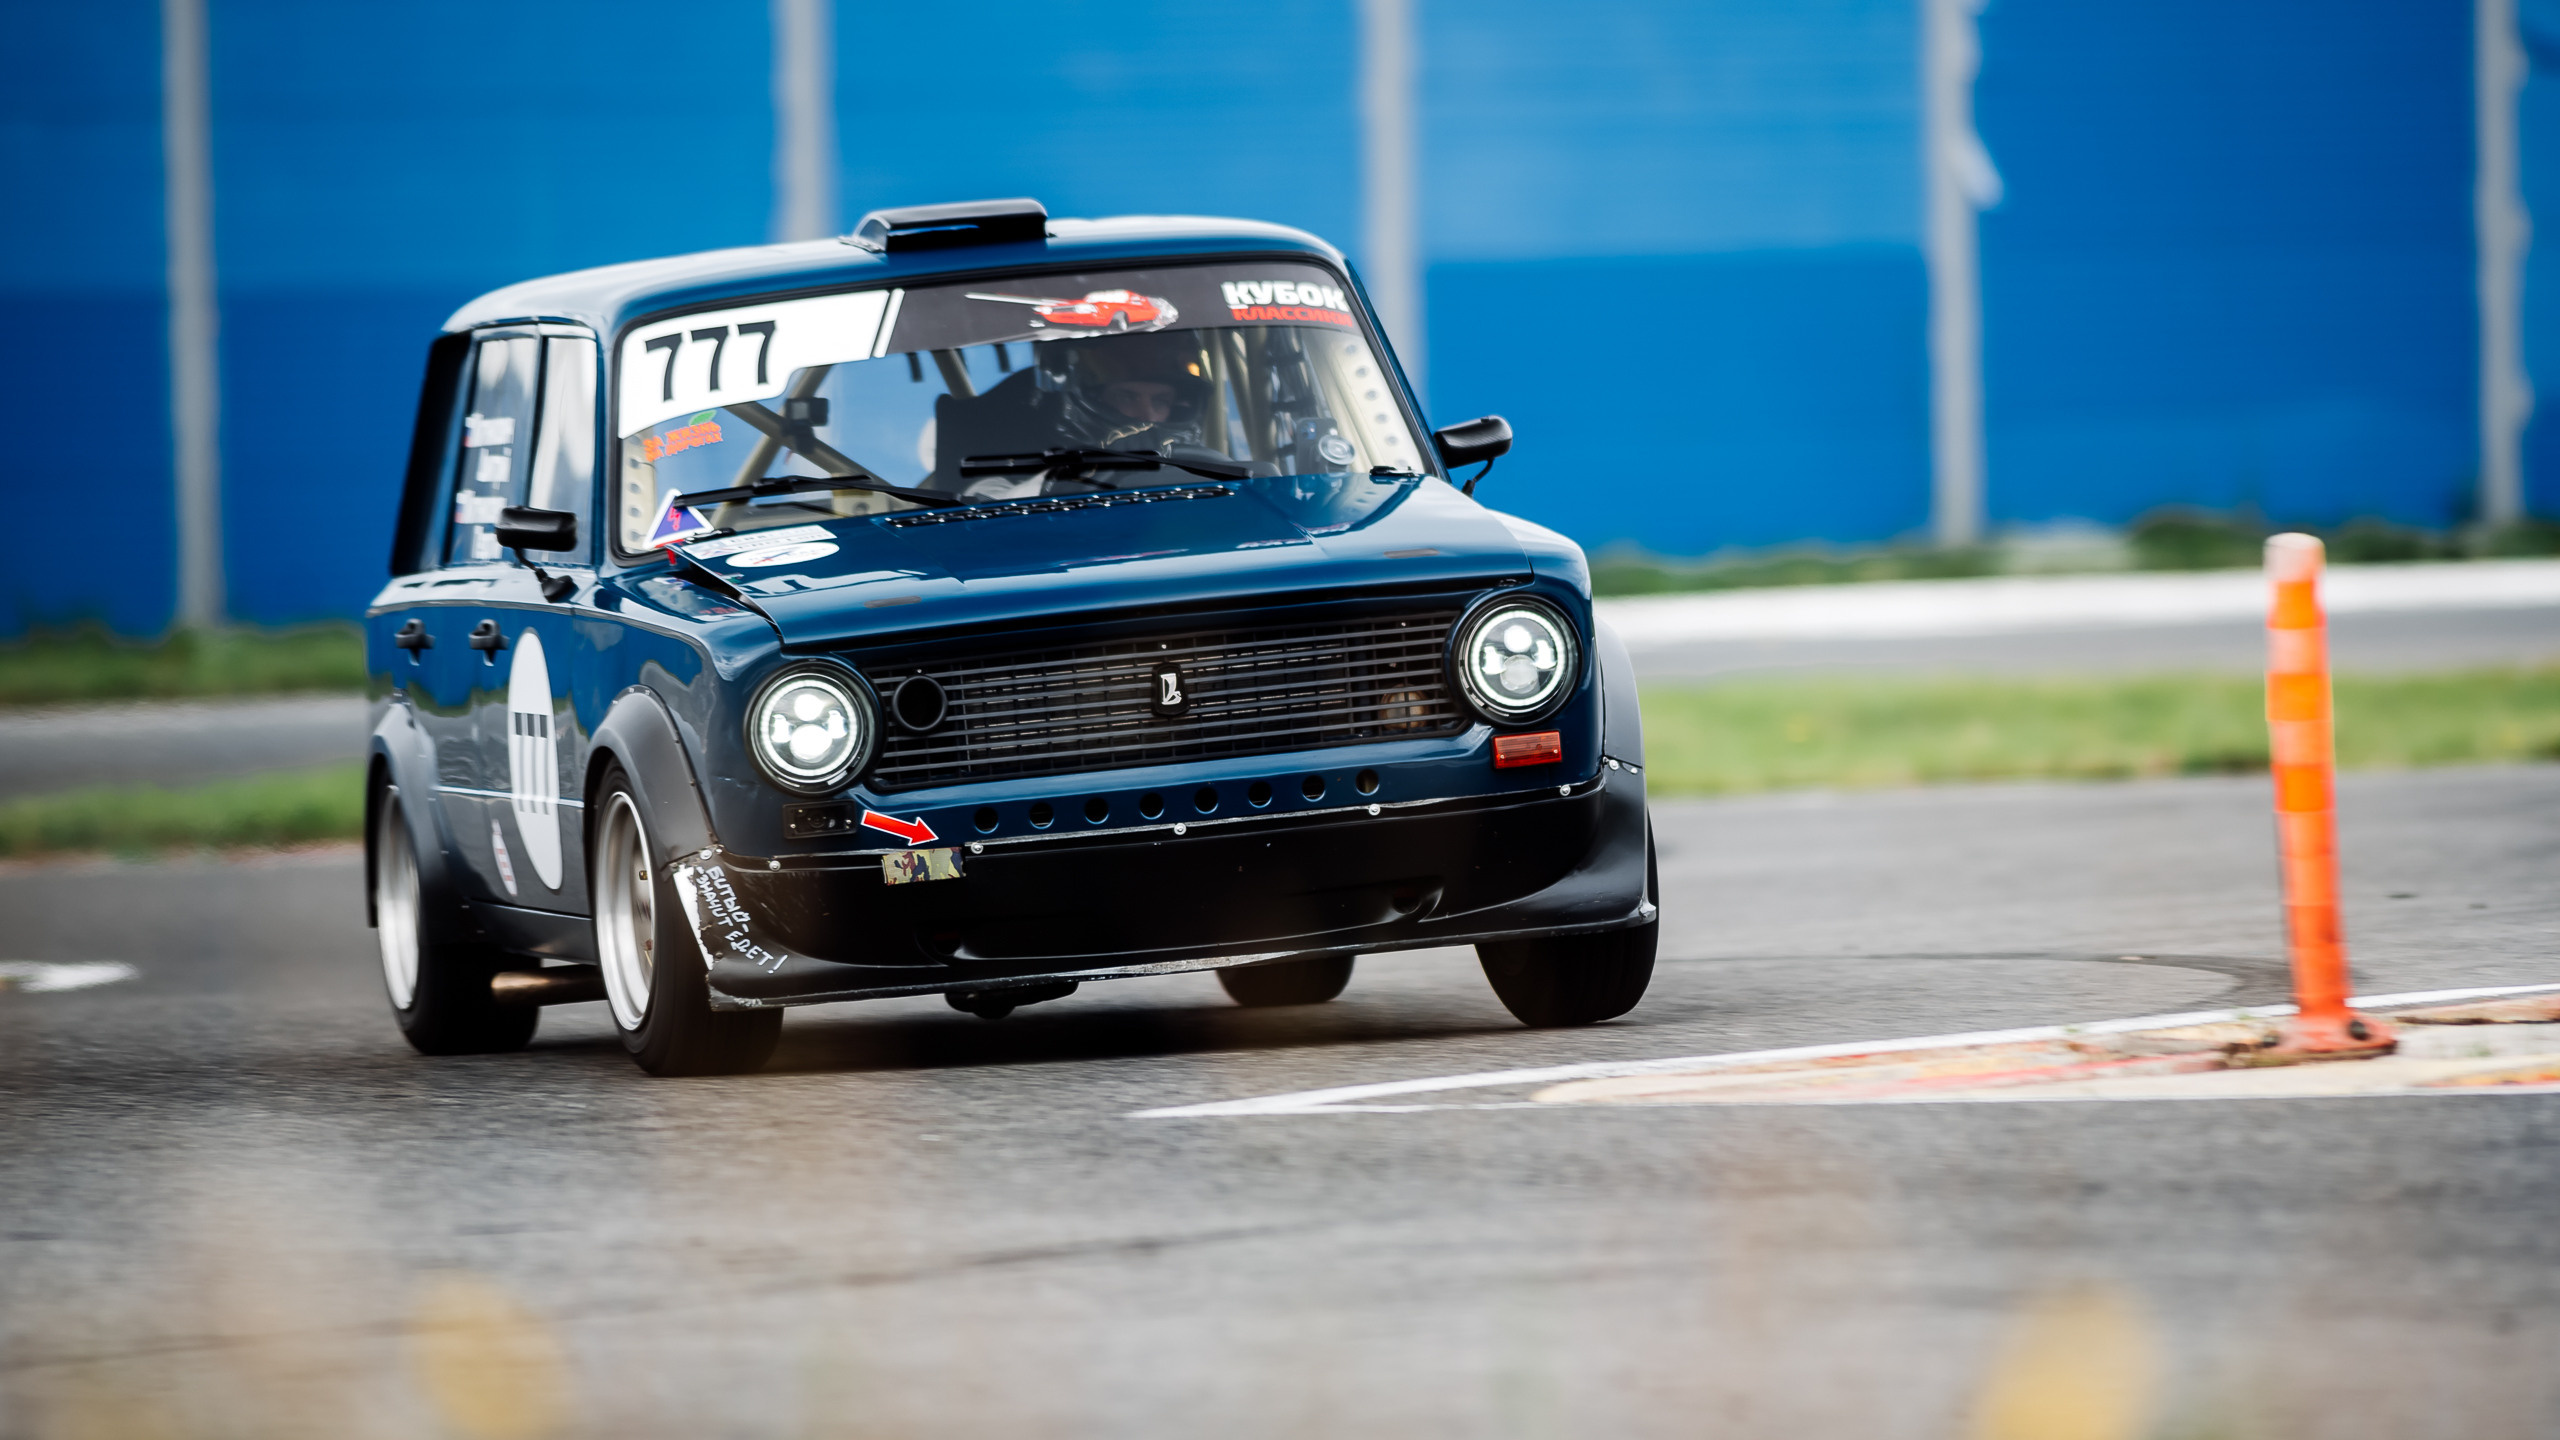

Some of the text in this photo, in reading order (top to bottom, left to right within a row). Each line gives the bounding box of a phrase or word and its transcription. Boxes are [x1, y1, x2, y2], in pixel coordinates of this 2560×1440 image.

[1221, 281, 1350, 312] КУБОК
[1231, 306, 1352, 327] КЛАССИКИ
[645, 320, 776, 402] 777
